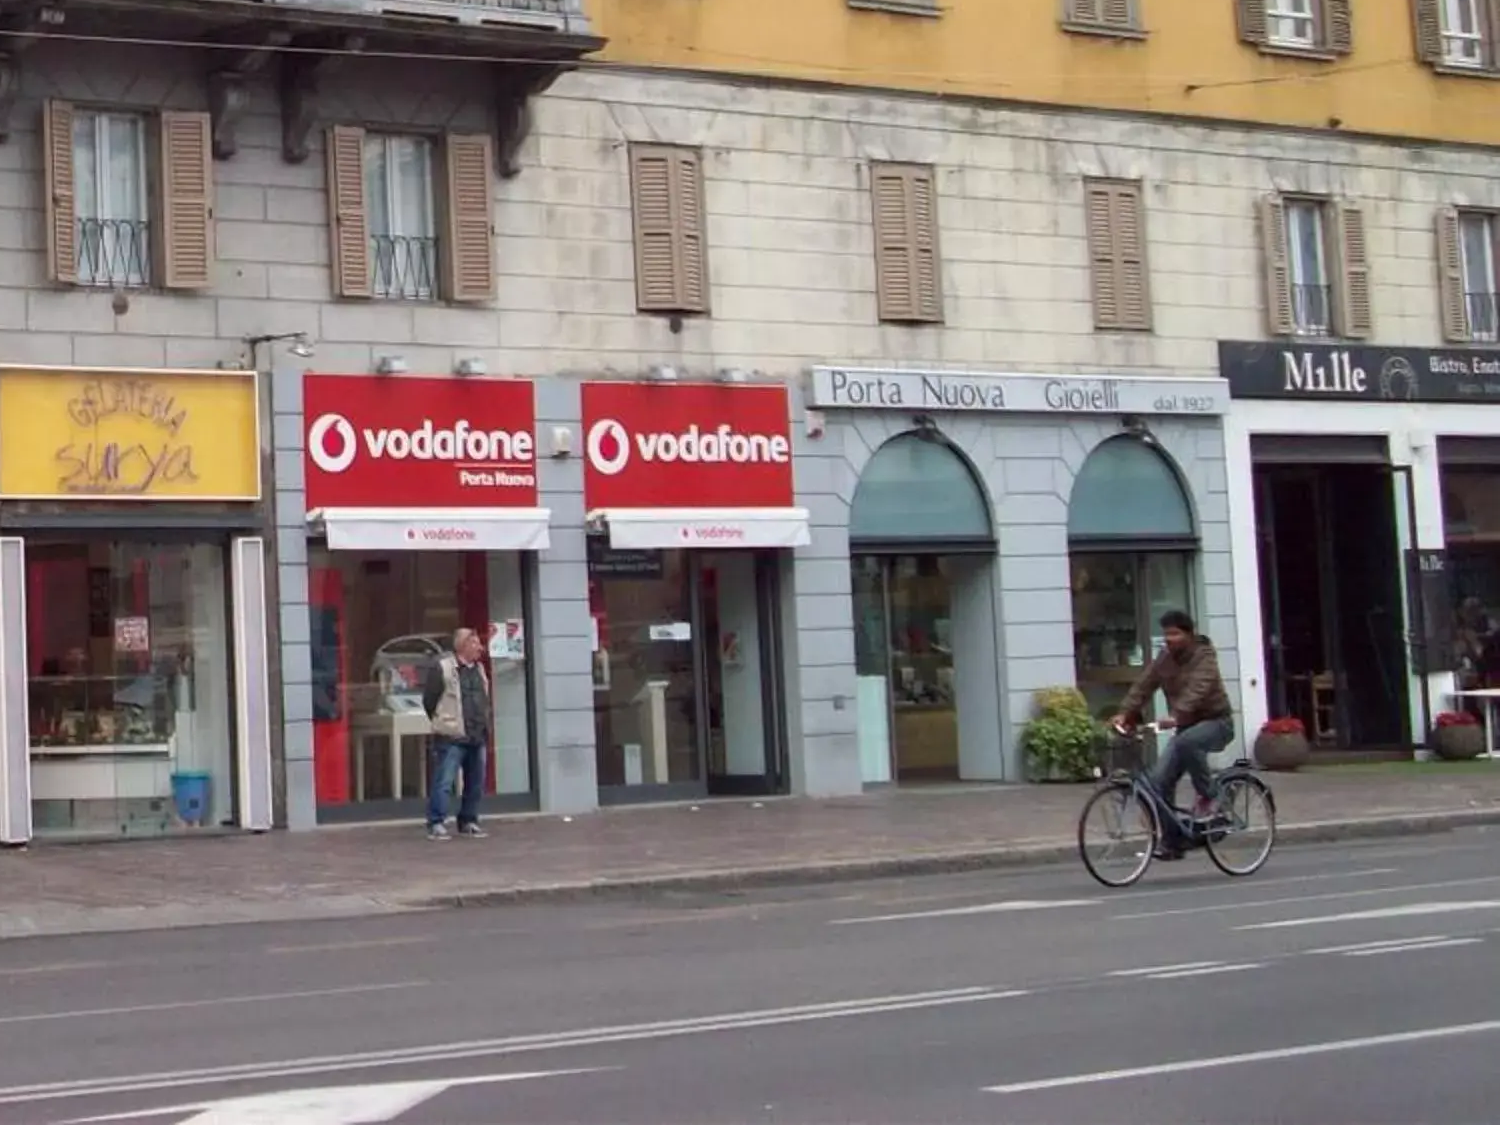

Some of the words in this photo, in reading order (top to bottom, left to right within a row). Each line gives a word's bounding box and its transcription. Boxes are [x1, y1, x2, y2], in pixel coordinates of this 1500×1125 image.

[830, 369, 903, 405] Porta
[922, 375, 1006, 408] Nuova
[1044, 378, 1120, 410] Gioielli
[1153, 394, 1177, 411] dal
[362, 418, 533, 460] vodafone
[634, 423, 789, 463] vodafone
[459, 470, 494, 487] Porta
[495, 471, 535, 487] Nuova
[422, 527, 477, 541] vodafone
